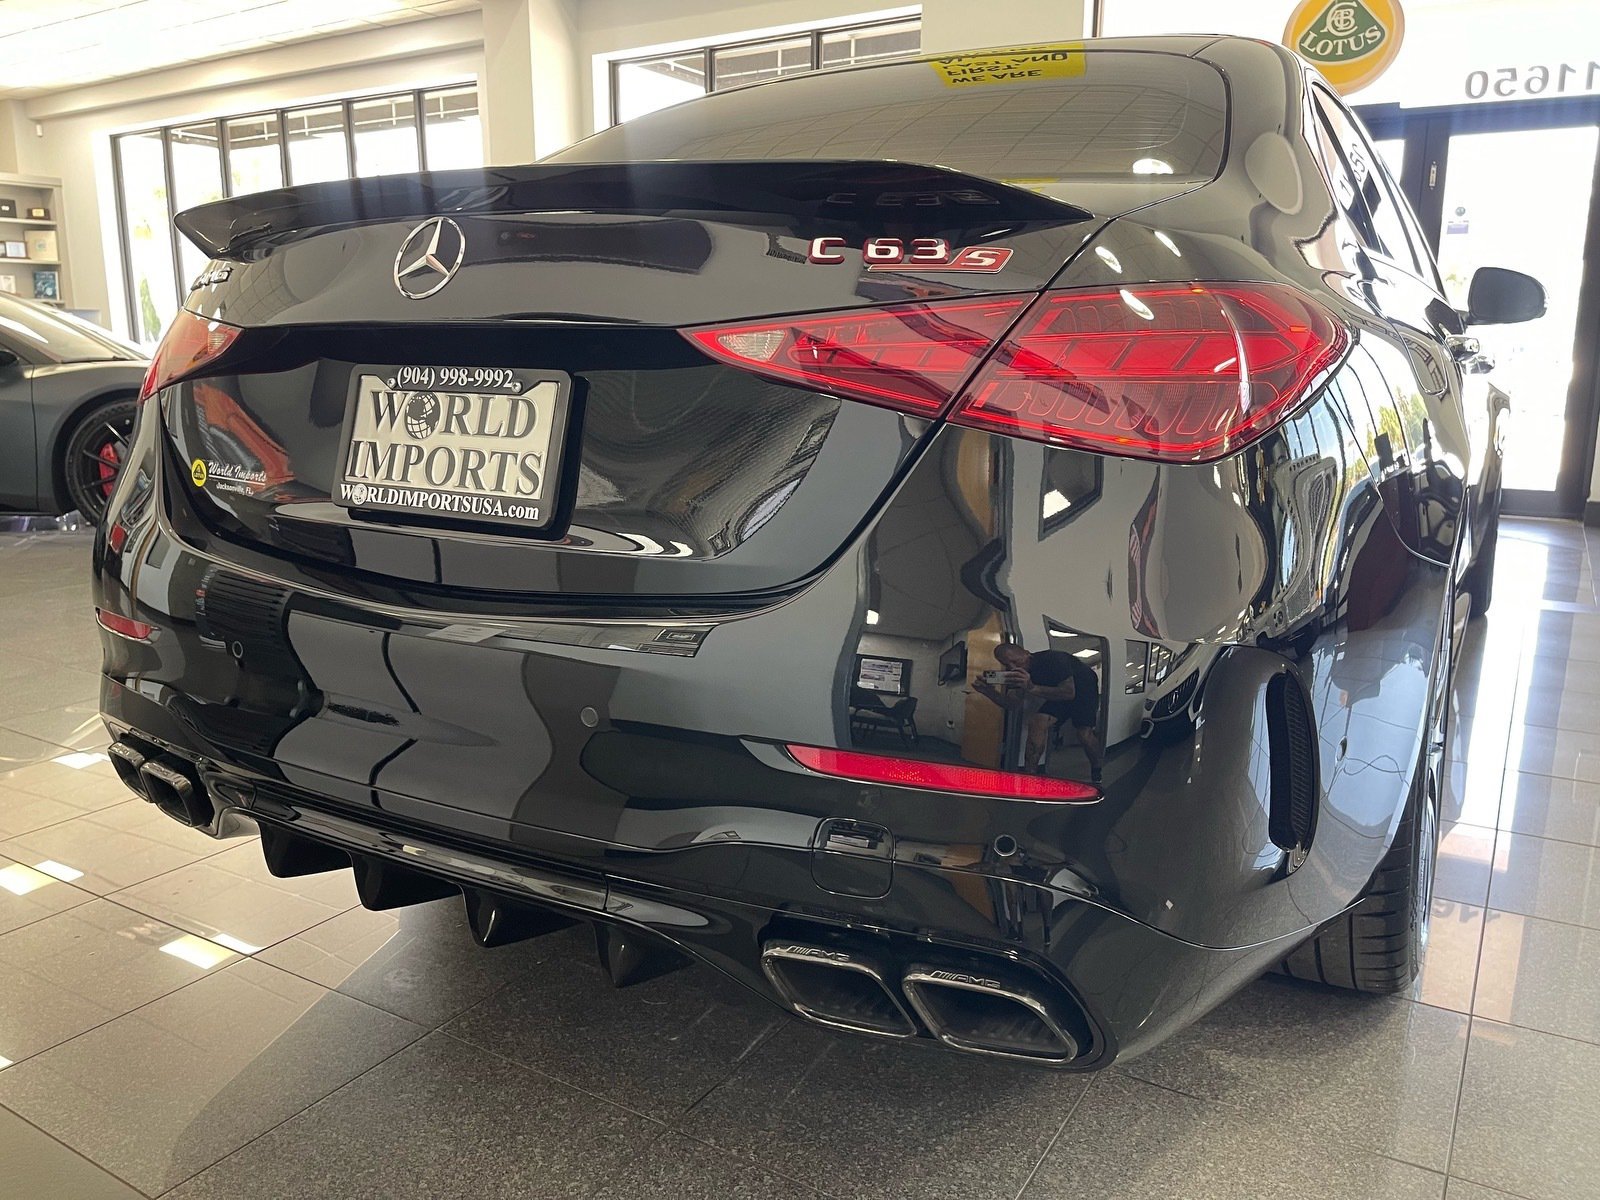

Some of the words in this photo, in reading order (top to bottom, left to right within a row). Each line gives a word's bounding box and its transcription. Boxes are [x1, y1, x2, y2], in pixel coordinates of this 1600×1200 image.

[1301, 24, 1382, 56] LOTUS
[808, 237, 847, 265] C
[862, 237, 951, 265] 63
[960, 250, 1001, 267] S
[397, 366, 436, 390] (904)
[439, 367, 514, 389] 998-9992
[371, 389, 538, 440] WORLD
[208, 462, 233, 477] World
[234, 465, 268, 482] Imports
[347, 440, 543, 497] IMPORTS
[340, 484, 540, 521] WORLDIMPORTSUSA.com
